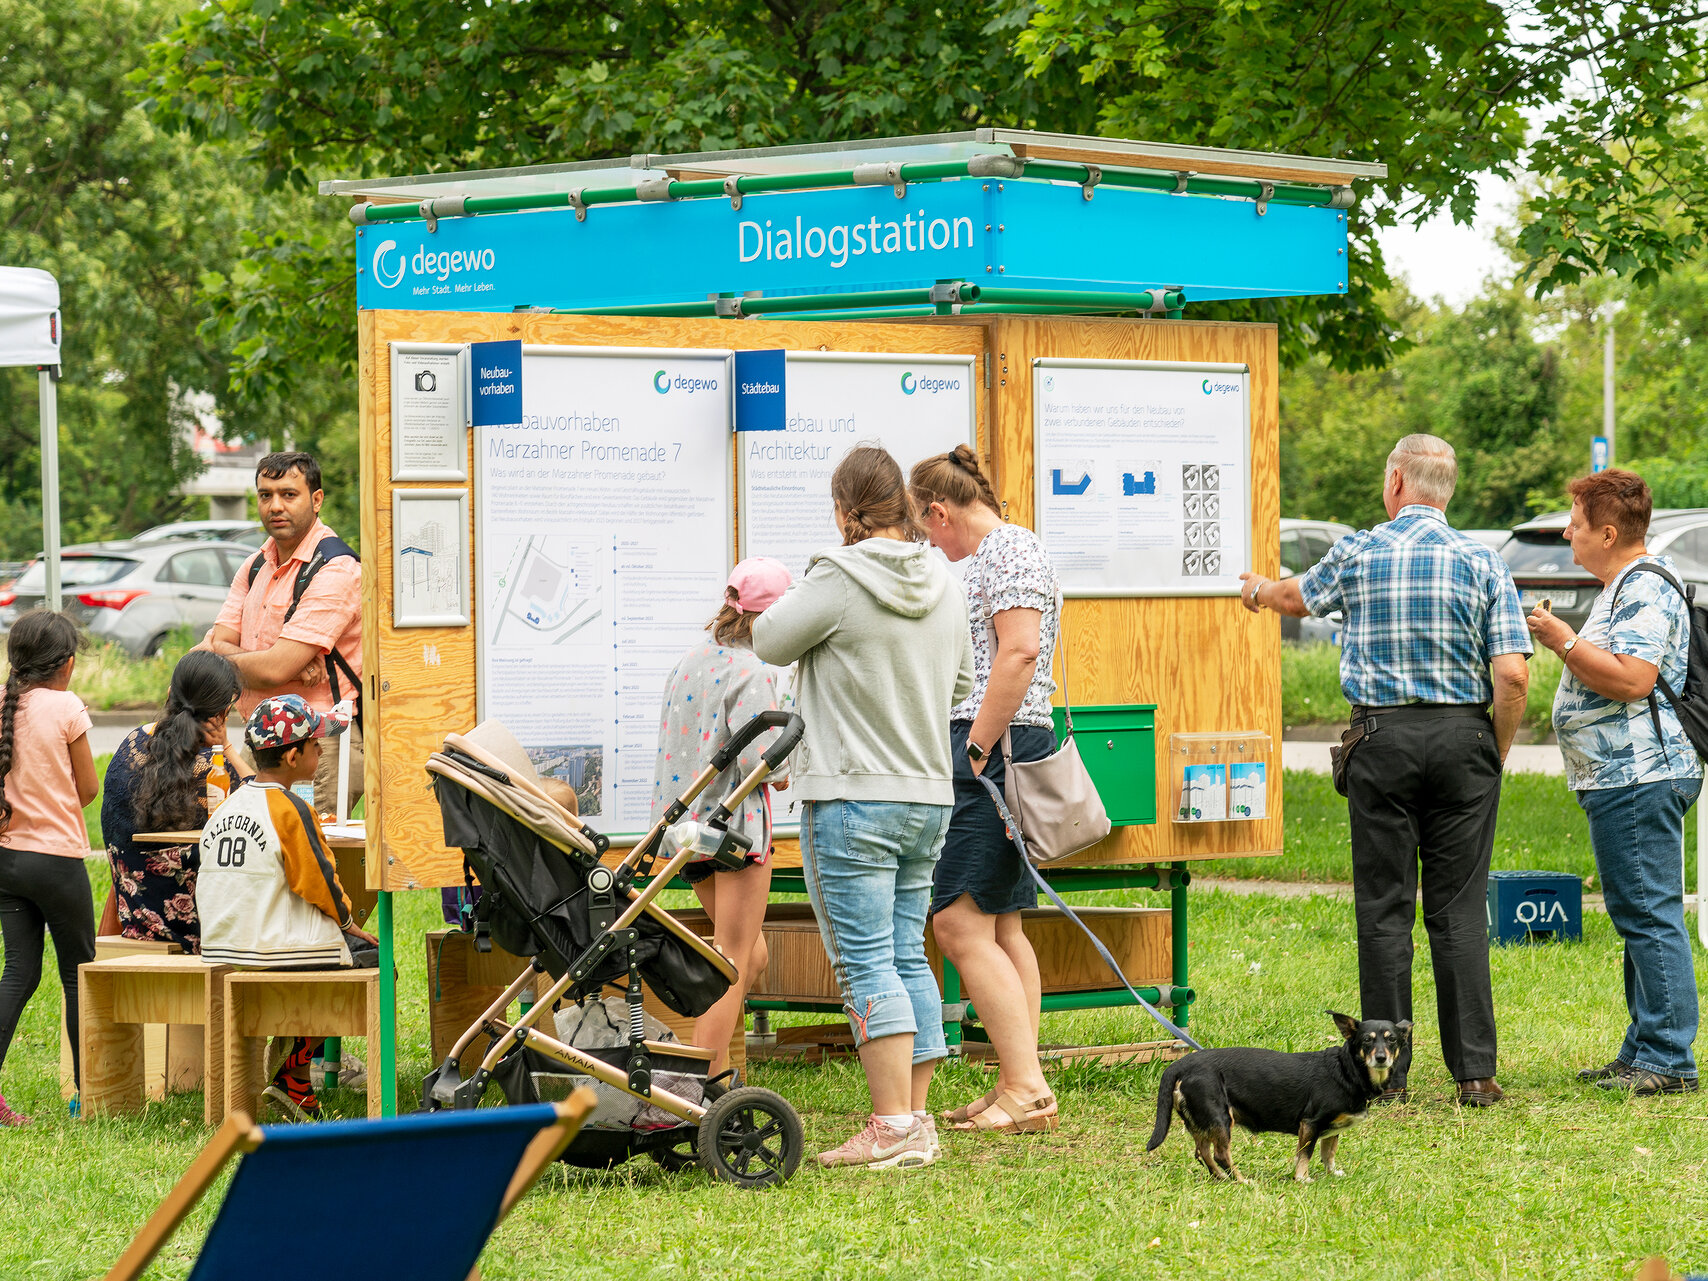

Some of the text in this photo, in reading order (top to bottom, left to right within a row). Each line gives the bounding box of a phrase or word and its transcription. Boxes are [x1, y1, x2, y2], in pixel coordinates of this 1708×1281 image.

[738, 209, 973, 269] Dialogstation
[411, 242, 496, 276] degewo
[412, 281, 496, 296] Mehr Stadt. Mehr Leben.
[480, 366, 513, 380] Neubau-
[479, 381, 515, 396] vorhaben
[673, 374, 718, 394] degewo
[741, 382, 780, 395] Städtebau
[919, 375, 960, 394] degewo
[1214, 381, 1240, 394] degewo
[1044, 403, 1185, 415] Warum haben wir uns für den Neubau von
[490, 410, 620, 432] bauvorhaben
[829, 412, 856, 433] und
[1044, 417, 1185, 428] zwei verbundenen Gebäuden entschieden?
[489, 438, 682, 462] Marzahner Promenade 7
[750, 440, 831, 461] Architektur
[490, 467, 666, 483] Was wird an der Marzahner Promenade gebaut?
[751, 469, 766, 479] Was
[766, 469, 797, 480] entsteht
[799, 469, 808, 479] im
[202, 815, 267, 853] CALIFORNIA
[217, 836, 247, 868] 08
[555, 1049, 596, 1072] AMAIA
